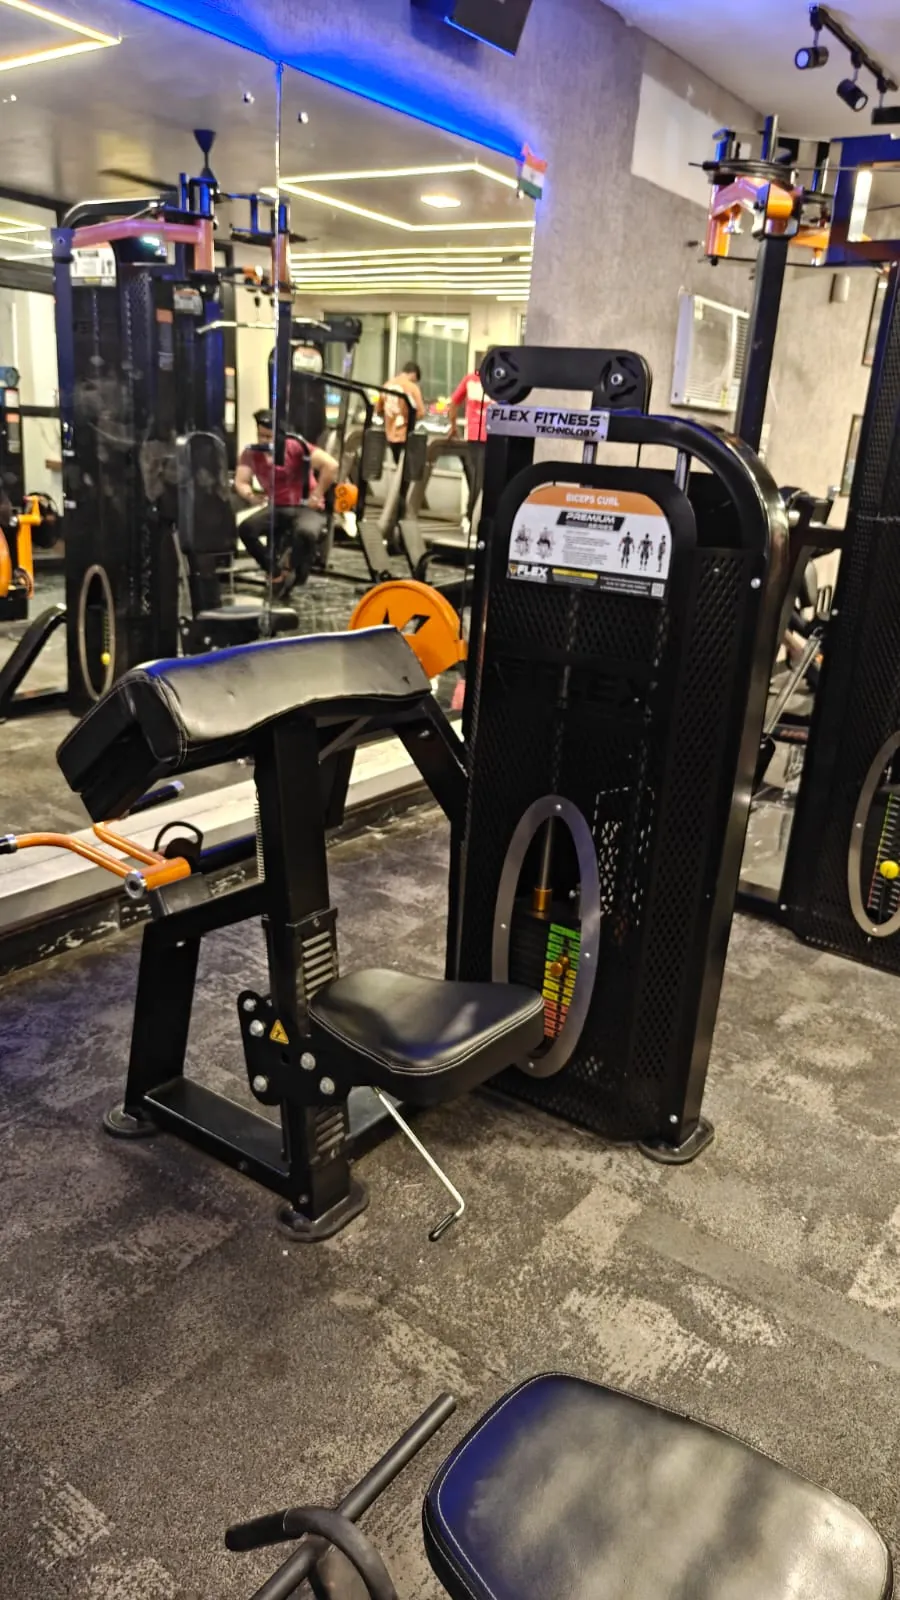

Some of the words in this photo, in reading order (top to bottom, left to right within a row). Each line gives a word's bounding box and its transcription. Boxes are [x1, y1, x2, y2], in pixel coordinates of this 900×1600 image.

[491, 409, 530, 422] FLEX
[534, 411, 601, 427] FITNESS
[536, 425, 598, 437] TECHNOLOGY
[566, 493, 595, 505] BICEPS
[597, 495, 620, 506] CURL
[565, 511, 615, 524] PREMIUM
[516, 564, 549, 579] FLEX
